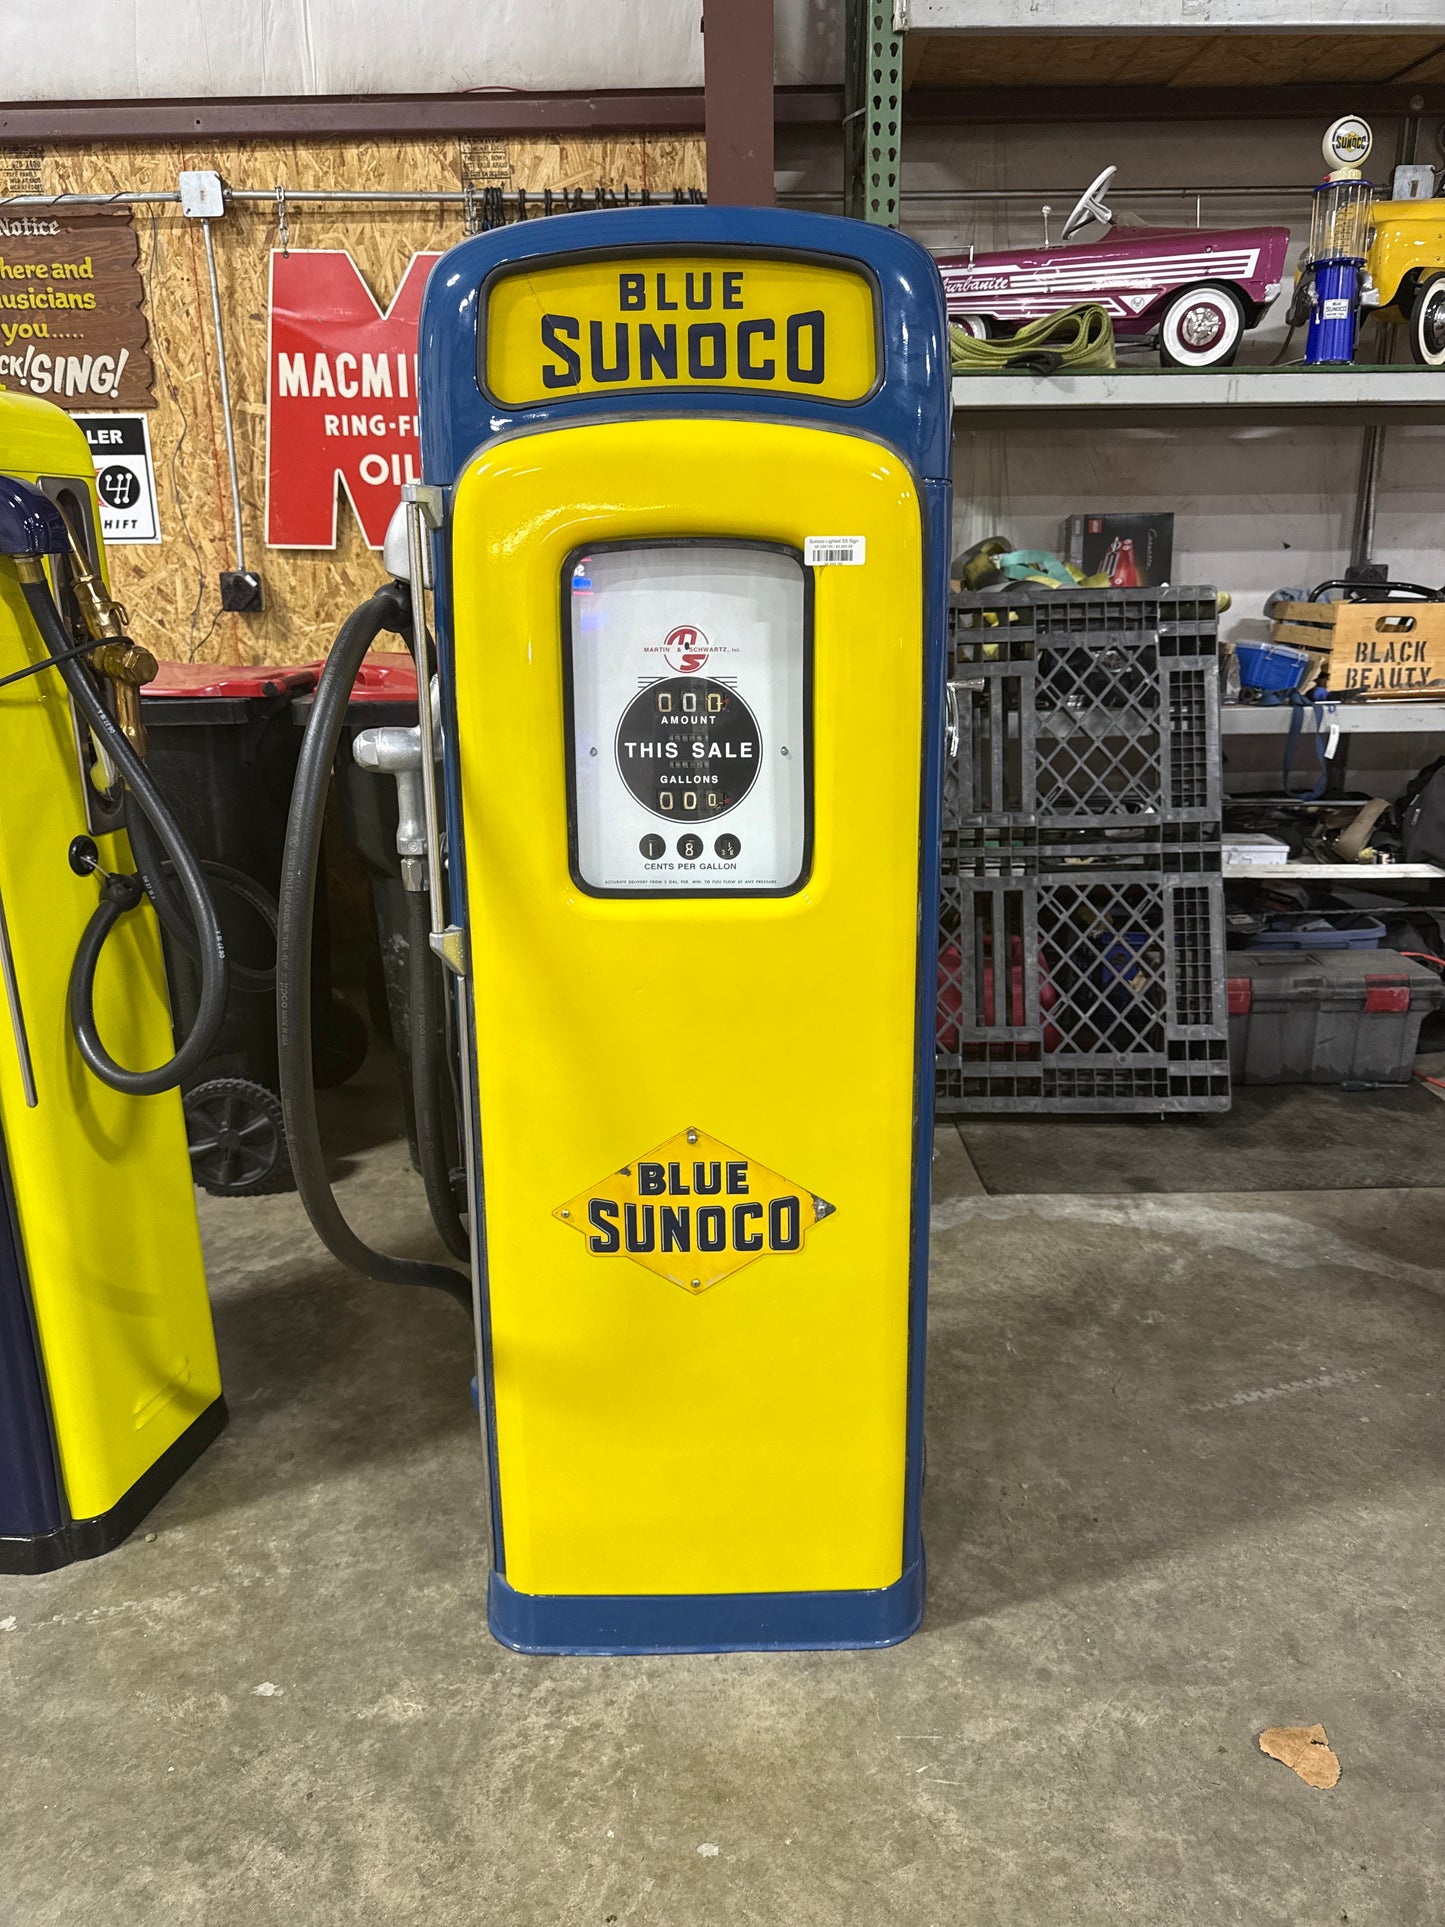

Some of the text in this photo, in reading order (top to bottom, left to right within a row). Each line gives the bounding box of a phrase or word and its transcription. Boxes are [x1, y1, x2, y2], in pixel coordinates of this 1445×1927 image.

[0, 216, 61, 236] Notice
[52, 256, 94, 279] and
[0, 287, 96, 309] usicians
[619, 272, 744, 311] BLUE
[540, 310, 825, 389] SUNOCO
[30, 348, 130, 398] SING!
[278, 352, 419, 398] MACMI
[86, 430, 124, 444] LER
[359, 454, 420, 486] OIL
[104, 520, 138, 529] HIFT
[1355, 640, 1427, 663] BLACK
[1346, 667, 1432, 689] BEAUTY
[661, 716, 716, 724] AMOUNT
[624, 742, 753, 758] THIS SALE
[685, 843, 693, 856] 8
[638, 1161, 749, 1196] BLUE
[588, 1195, 800, 1253] SUNOCO
